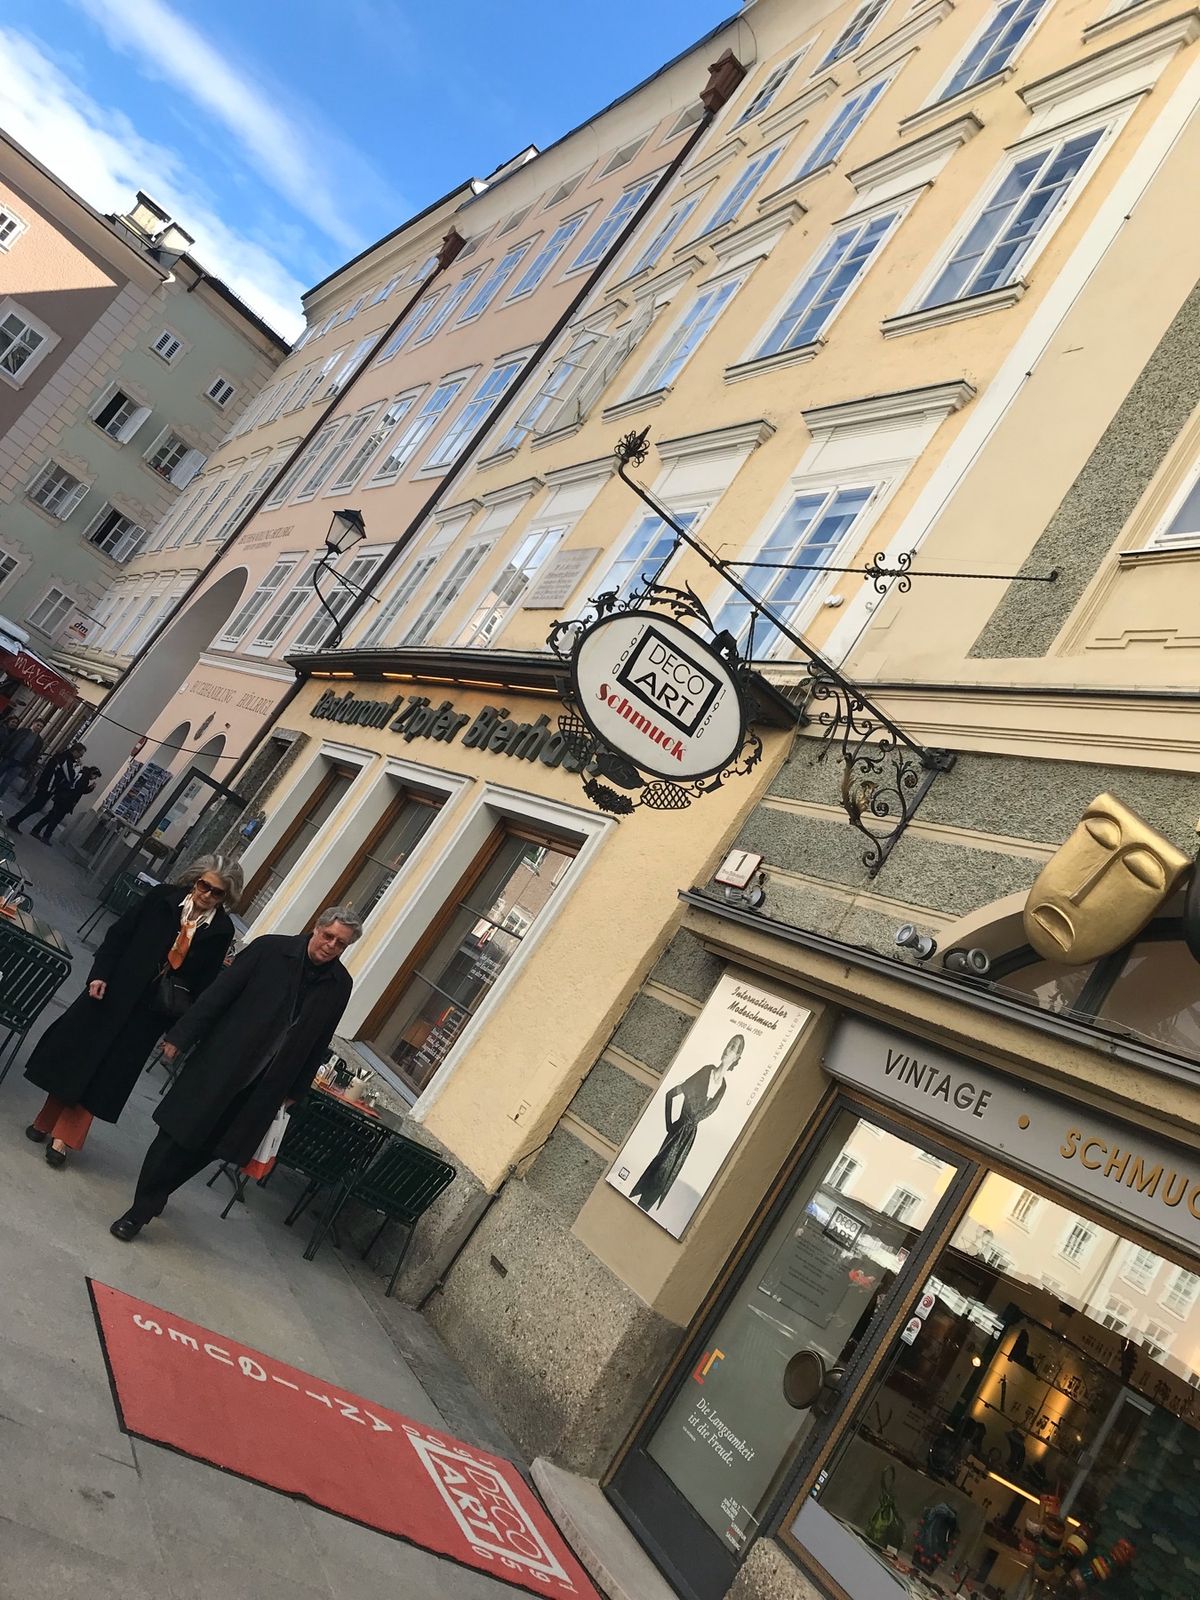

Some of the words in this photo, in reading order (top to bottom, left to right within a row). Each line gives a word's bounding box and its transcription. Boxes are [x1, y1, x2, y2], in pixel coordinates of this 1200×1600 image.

[73, 621, 89, 634] dm
[611, 624, 645, 675] 1900
[634, 671, 694, 717] ART
[648, 643, 705, 695] DECO
[310, 687, 404, 730] Restaurant
[389, 695, 470, 744] Zipfer
[595, 683, 687, 762] Schmuck
[696, 689, 727, 739] 1950
[735, 853, 749, 872] 1
[731, 986, 788, 1019] Internationaler
[885, 1049, 993, 1119] VINTAGE
[133, 1314, 392, 1432] ANTIQUES
[688, 1411, 700, 1427] ist
[697, 1423, 710, 1439] die
[708, 1434, 733, 1467] Freude.
[696, 1397, 710, 1415] Die
[708, 1410, 755, 1461] Langsamkeit
[429, 1454, 504, 1543] ART
[464, 1467, 542, 1559] DECO
